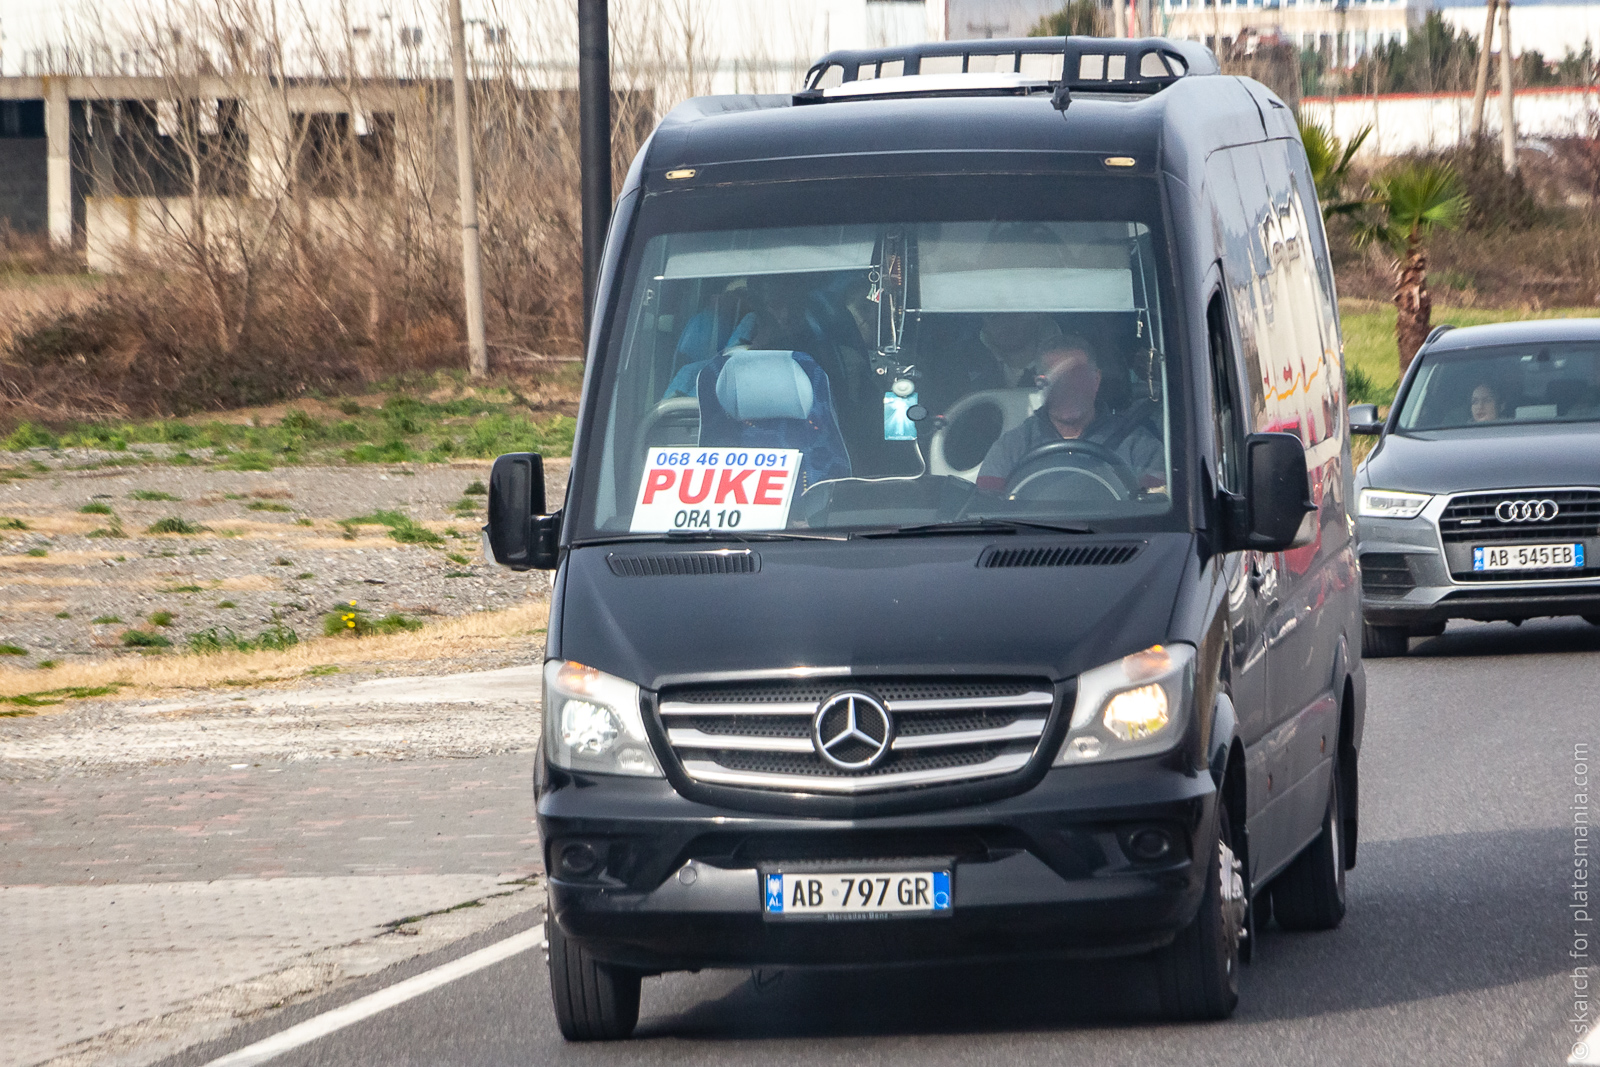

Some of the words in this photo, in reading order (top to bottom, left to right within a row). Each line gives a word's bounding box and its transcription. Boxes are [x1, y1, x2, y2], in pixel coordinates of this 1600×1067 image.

[656, 452, 690, 466] 068
[696, 452, 720, 466] 46
[725, 452, 749, 467] 00
[754, 453, 788, 467] 091
[642, 468, 789, 505] PUKE
[674, 509, 711, 528] ORA
[717, 509, 742, 528] 10
[1489, 549, 1509, 566] AB
[1519, 547, 1549, 565] 545
[1553, 546, 1572, 563] EB
[769, 896, 782, 907] AL
[792, 879, 824, 907] AB
[840, 877, 892, 907] 797
[897, 877, 931, 906] GR
